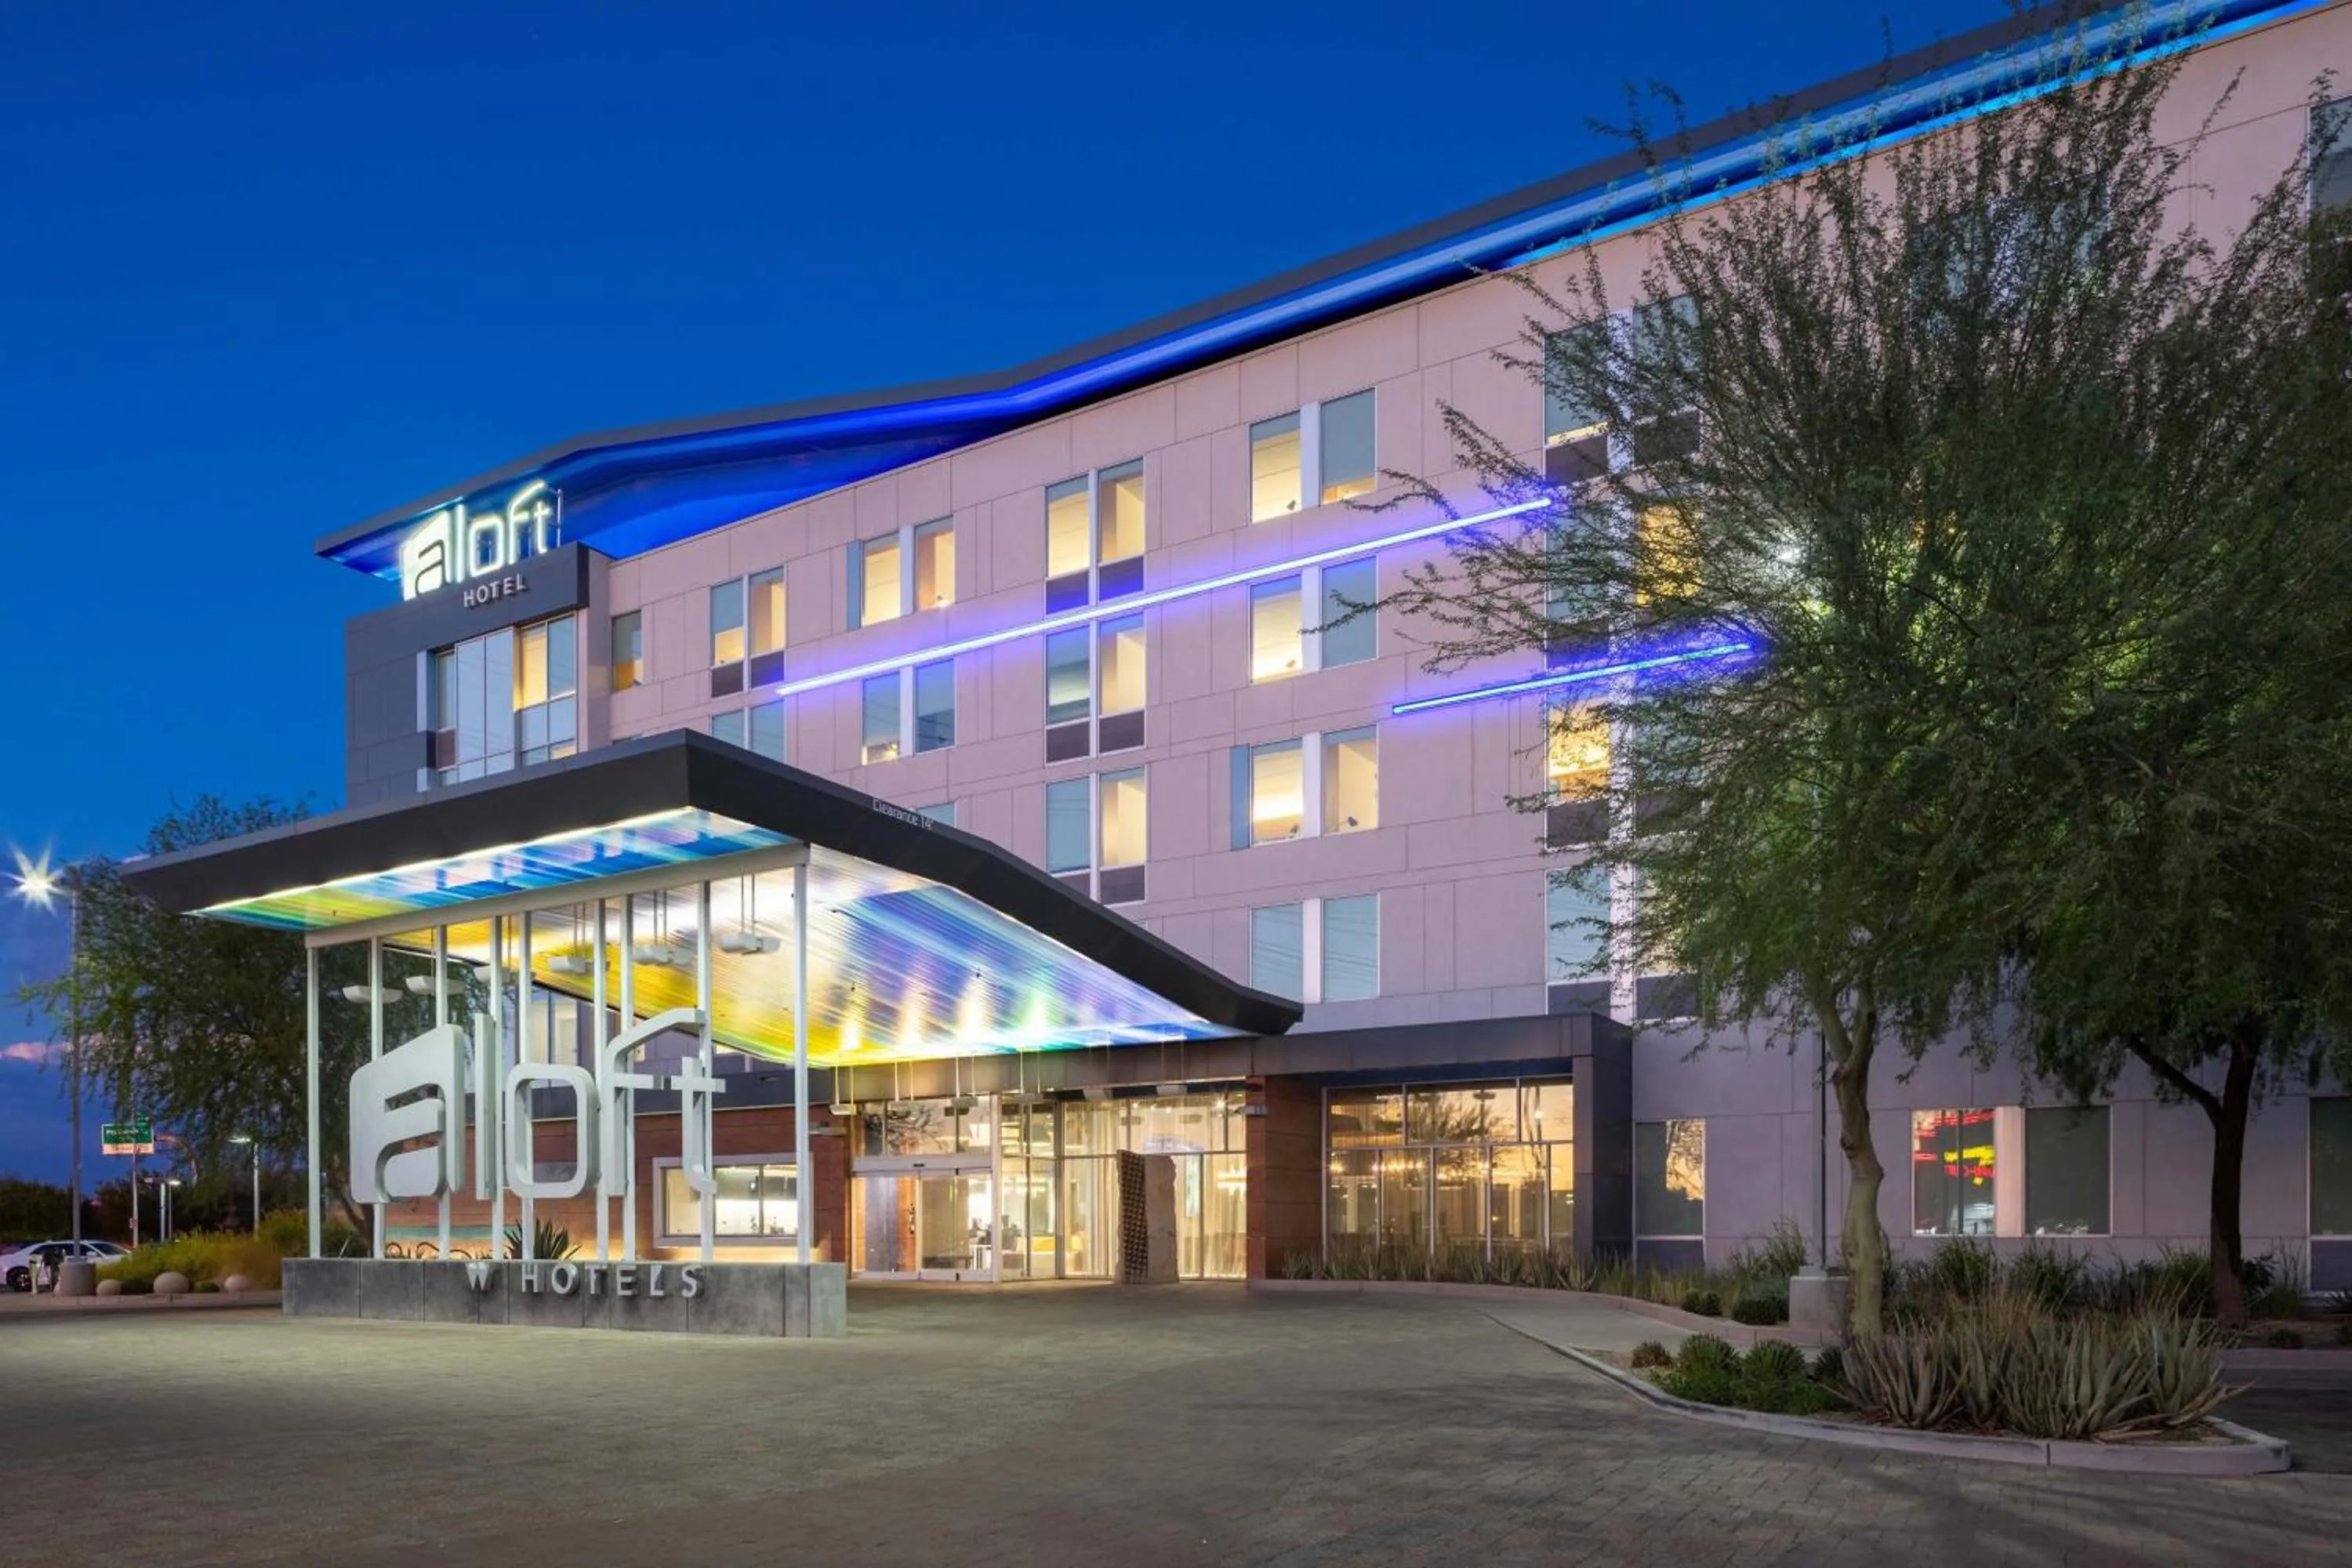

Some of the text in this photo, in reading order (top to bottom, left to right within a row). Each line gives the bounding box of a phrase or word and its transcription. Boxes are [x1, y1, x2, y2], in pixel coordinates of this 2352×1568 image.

[401, 479, 551, 601] aloft
[463, 574, 527, 608] HOTEL
[873, 800, 917, 826] Clearance
[349, 1008, 726, 1204] aloft
[466, 1263, 704, 1298] W HOTELS
